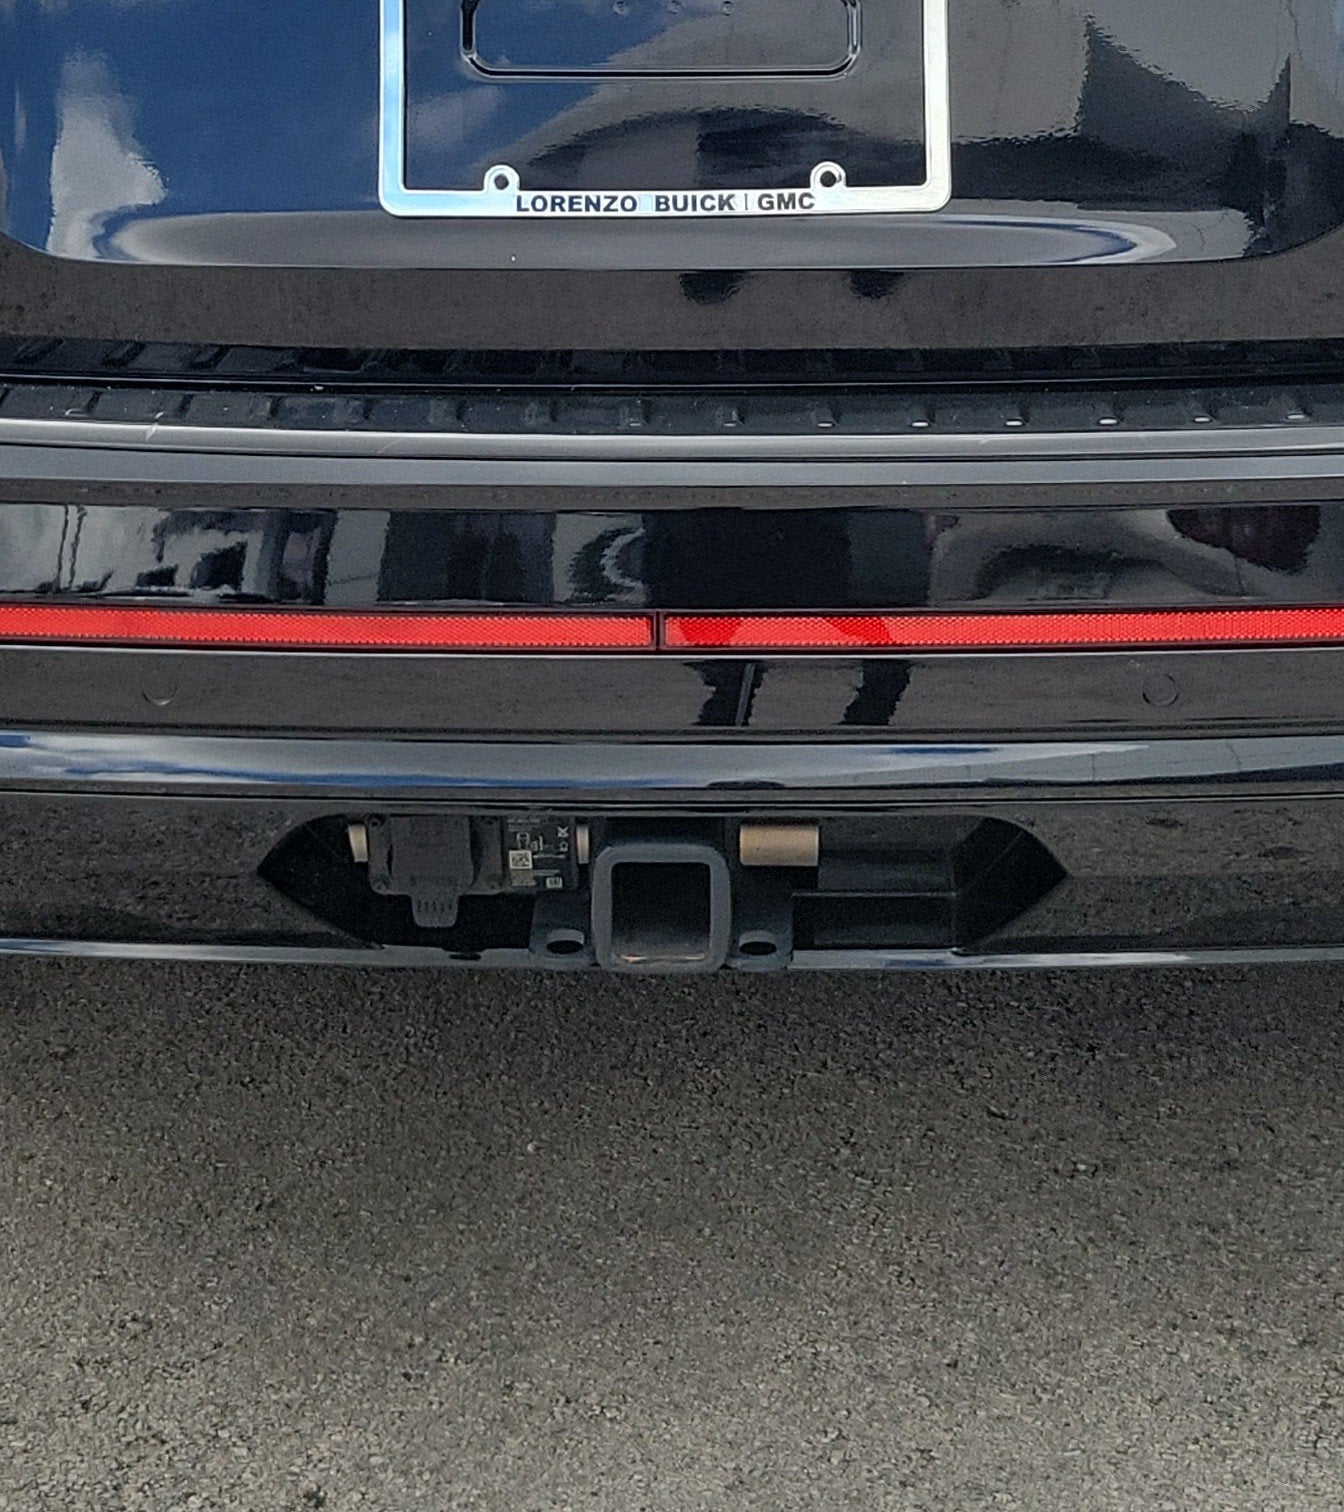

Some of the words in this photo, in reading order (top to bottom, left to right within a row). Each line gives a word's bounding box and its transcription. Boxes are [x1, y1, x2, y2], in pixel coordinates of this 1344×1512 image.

[515, 193, 638, 213] LORENZO
[654, 192, 737, 213] BUICK
[757, 191, 816, 211] GMC
